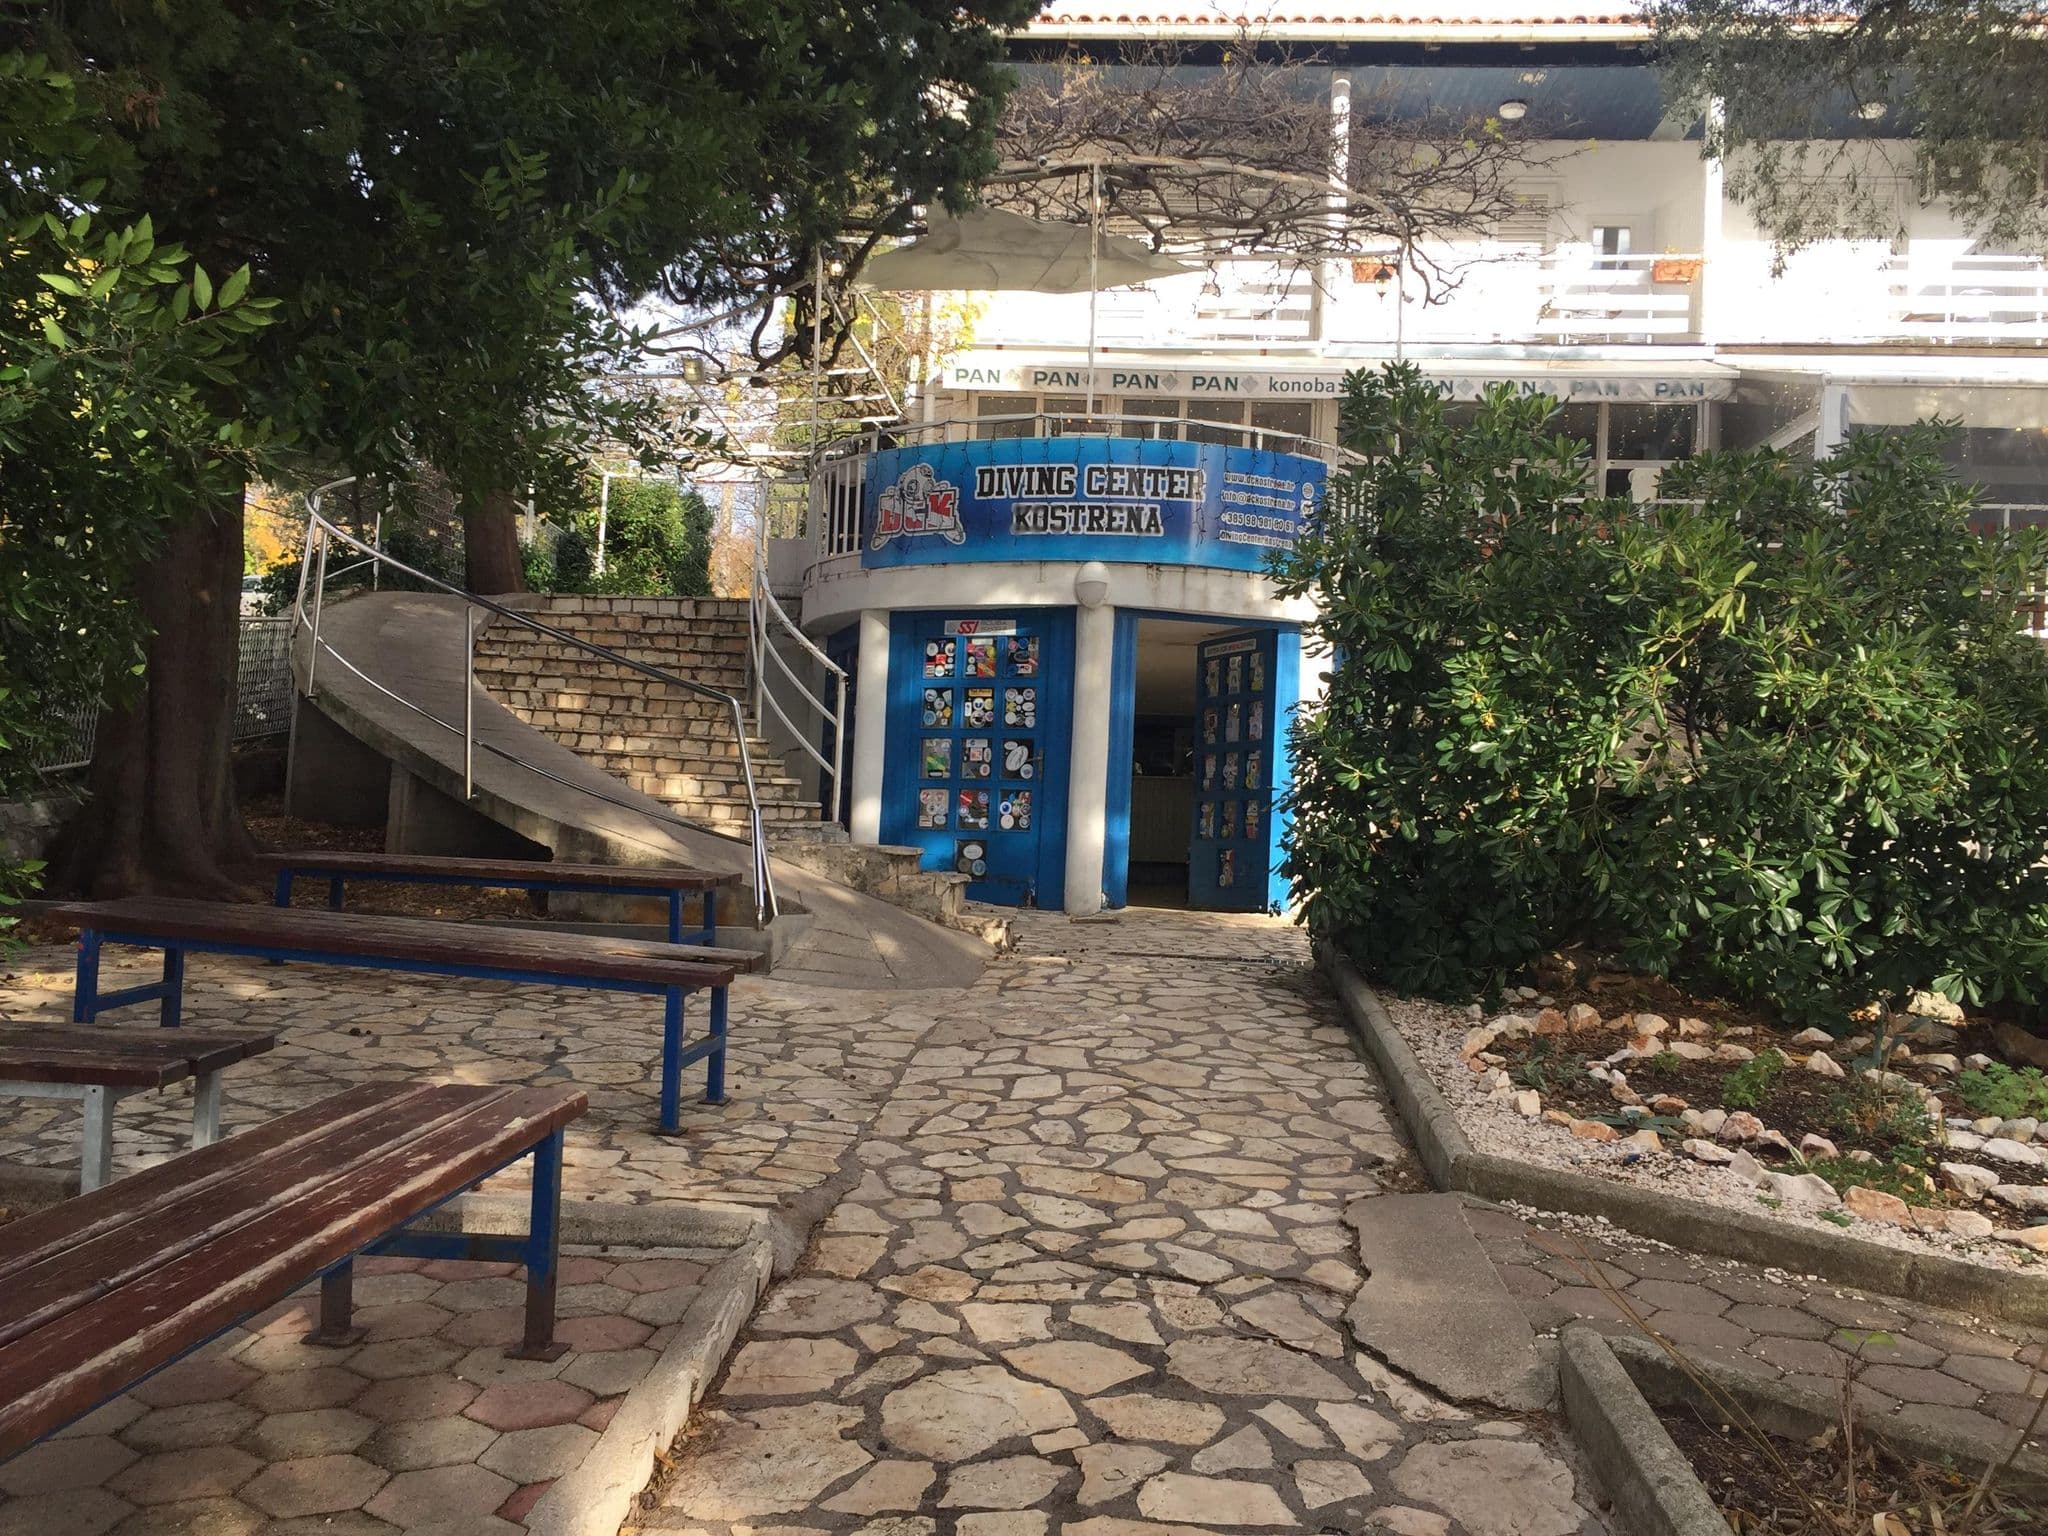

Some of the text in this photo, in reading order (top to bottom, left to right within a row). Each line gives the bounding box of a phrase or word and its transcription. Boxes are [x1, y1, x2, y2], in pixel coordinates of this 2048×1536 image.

[955, 368, 1000, 384] PAN
[1033, 371, 1080, 387] PAN
[1112, 373, 1158, 390] PAN
[1192, 375, 1238, 392] PAN
[1268, 376, 1335, 393] konoba
[1571, 381, 1620, 396] PAN
[1655, 381, 1704, 397] PAN
[976, 465, 1206, 501] DIVING CENTER
[879, 490, 957, 535] DCK
[1012, 503, 1163, 535] KOSTRENA
[957, 620, 979, 634] SSI
